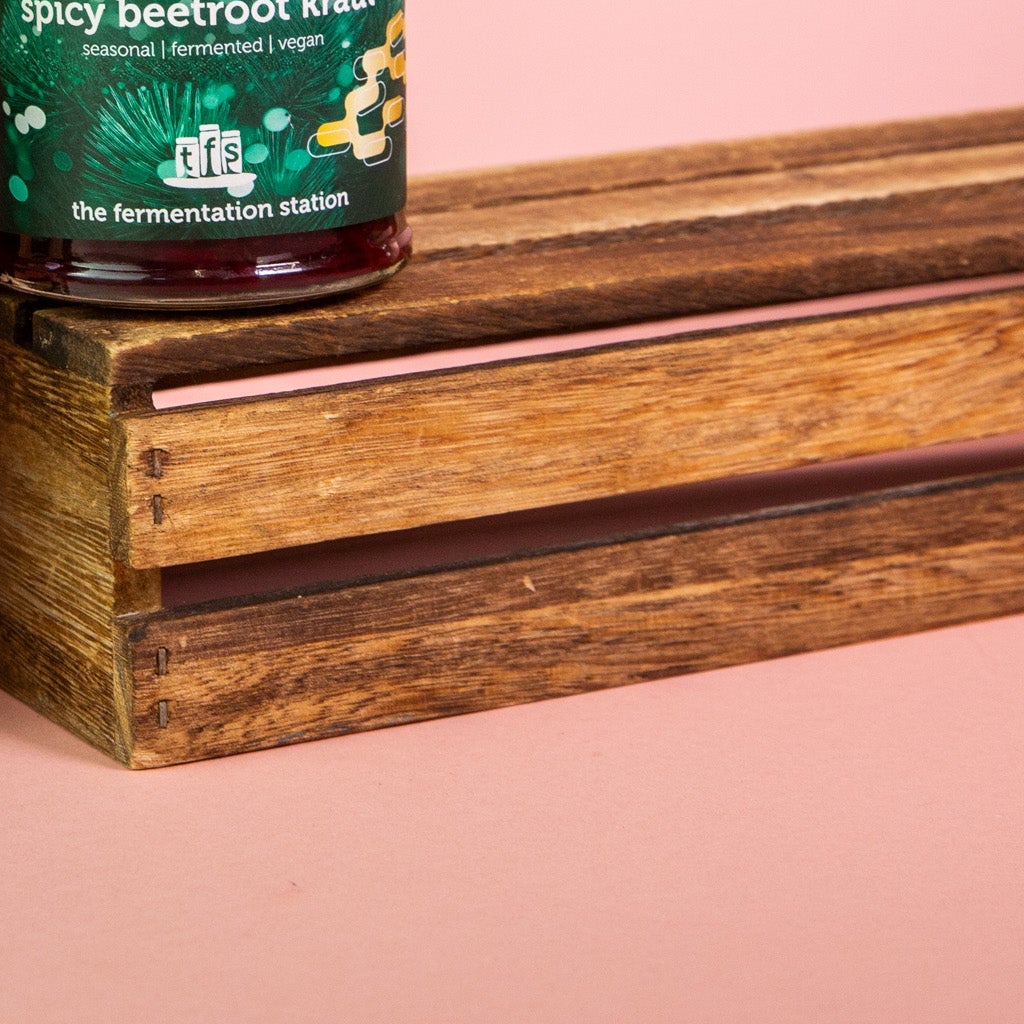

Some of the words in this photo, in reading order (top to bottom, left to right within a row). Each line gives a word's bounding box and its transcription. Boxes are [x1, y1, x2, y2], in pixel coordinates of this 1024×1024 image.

[82, 41, 156, 57] seasonal
[171, 36, 264, 57] fermented
[277, 33, 325, 52] vegan
[178, 136, 241, 178] tfs
[71, 200, 107, 222] the
[113, 201, 274, 224] fermentation
[279, 191, 350, 217] station
